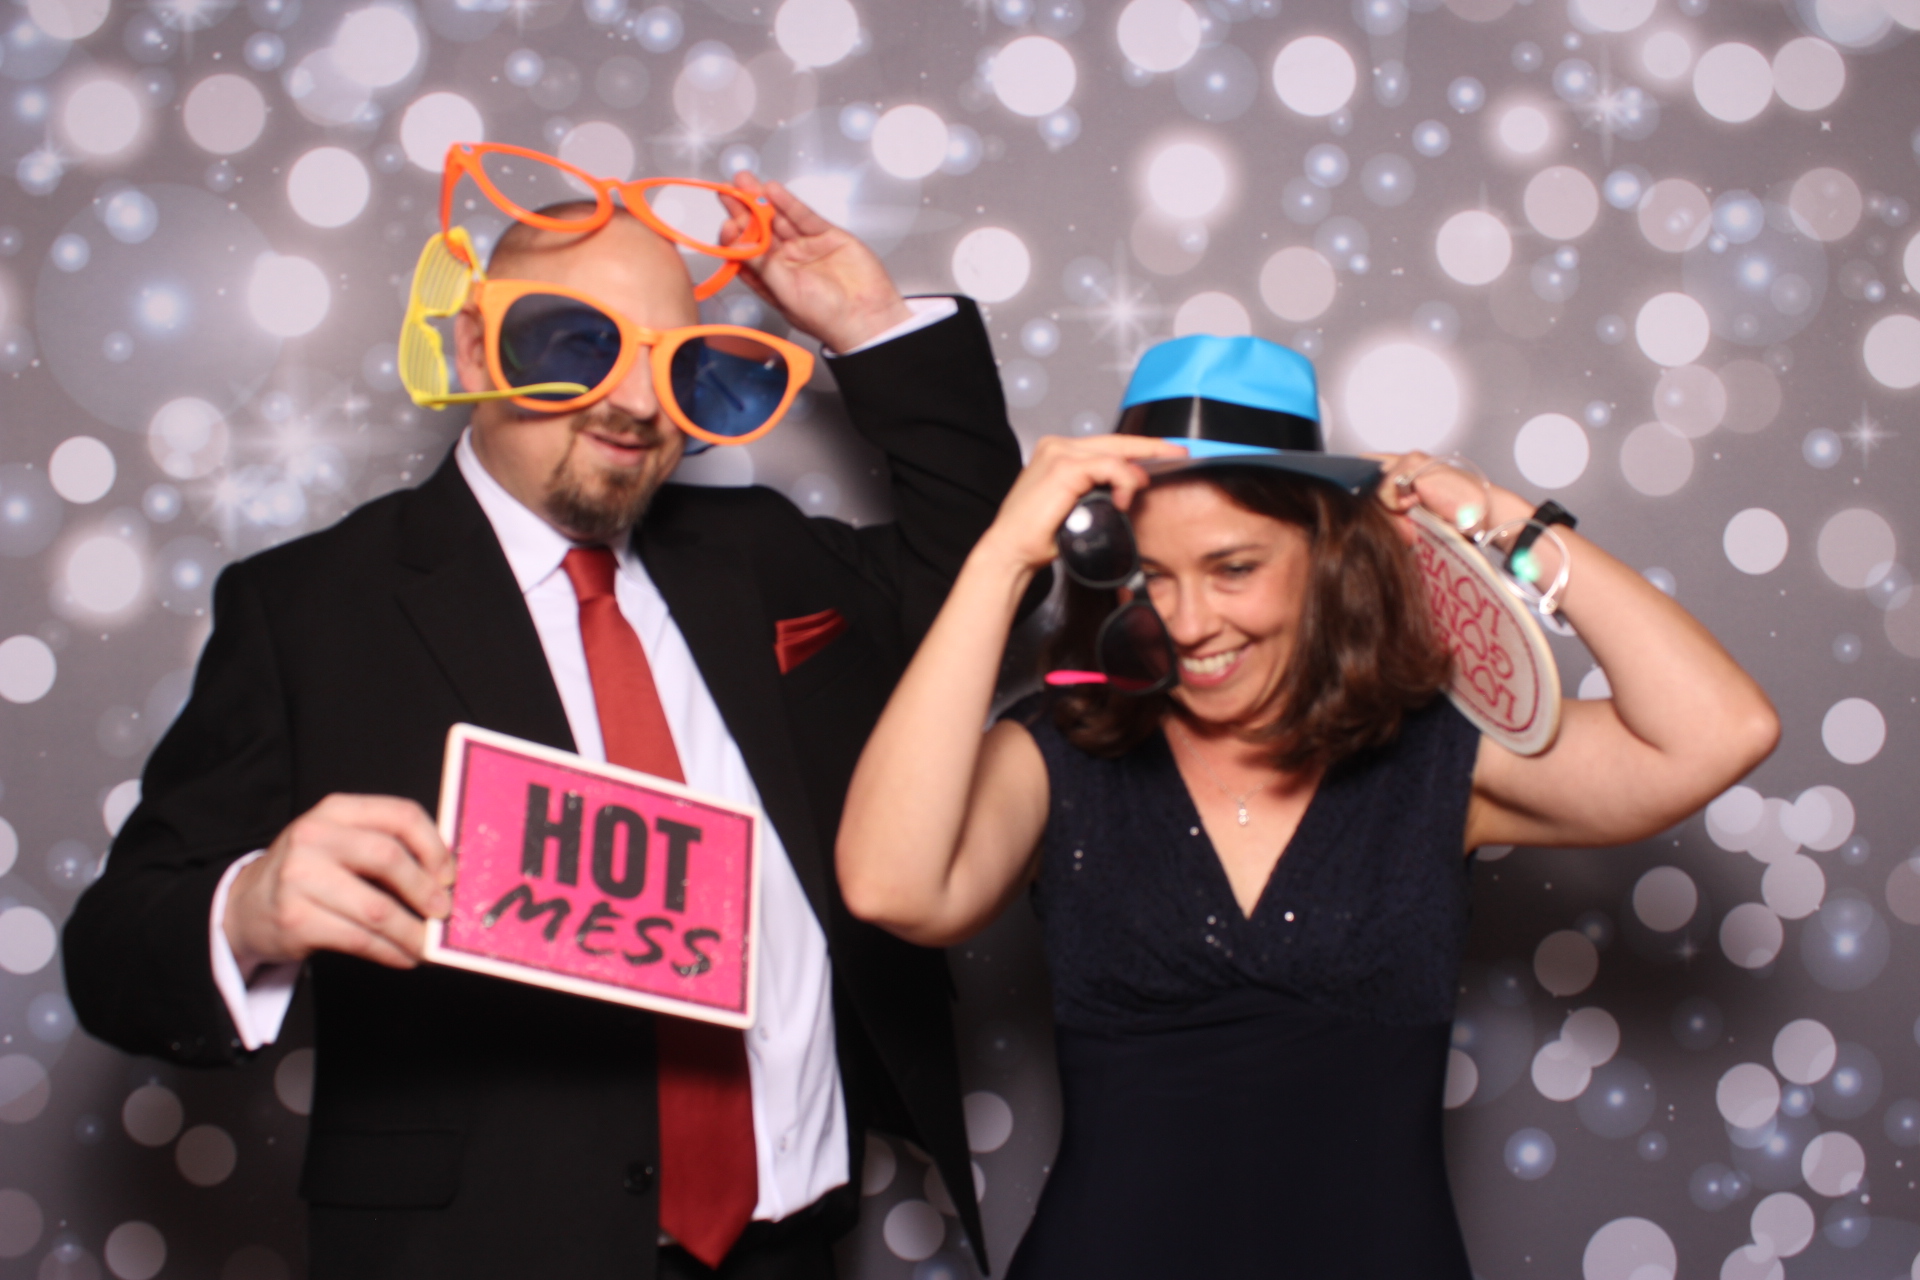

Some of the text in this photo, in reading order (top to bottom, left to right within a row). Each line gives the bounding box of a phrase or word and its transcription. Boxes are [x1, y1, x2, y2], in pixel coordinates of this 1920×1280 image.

[1416, 536, 1501, 636] LOVE
[520, 782, 703, 914] HOT
[482, 884, 721, 978] MESS
